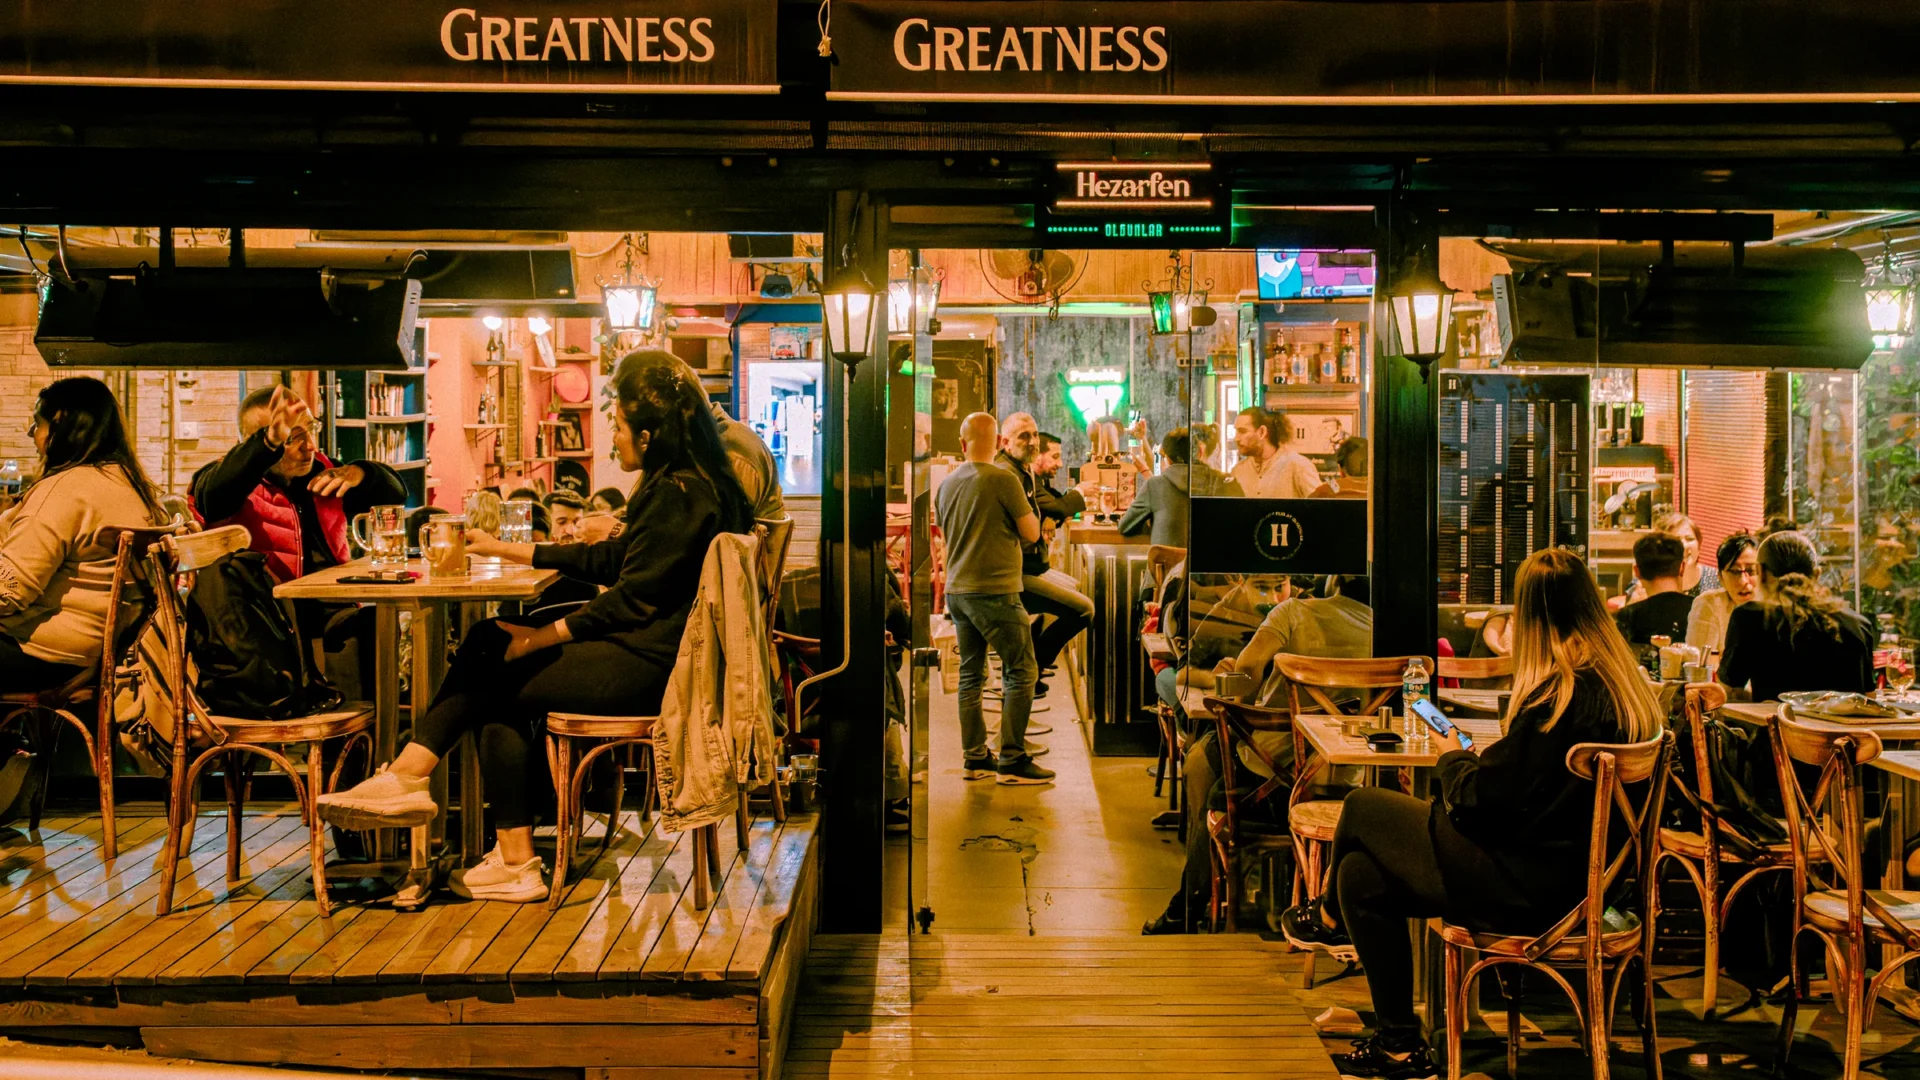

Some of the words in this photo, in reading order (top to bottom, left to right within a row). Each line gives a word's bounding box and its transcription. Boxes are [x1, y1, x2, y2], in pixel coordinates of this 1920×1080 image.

[441, 8, 715, 62] GREATNESS
[894, 18, 1168, 72] GREATNESS
[1077, 171, 1190, 197] Hezarfen
[1105, 223, 1163, 237] OLGUNLAR
[1270, 523, 1289, 546] H
